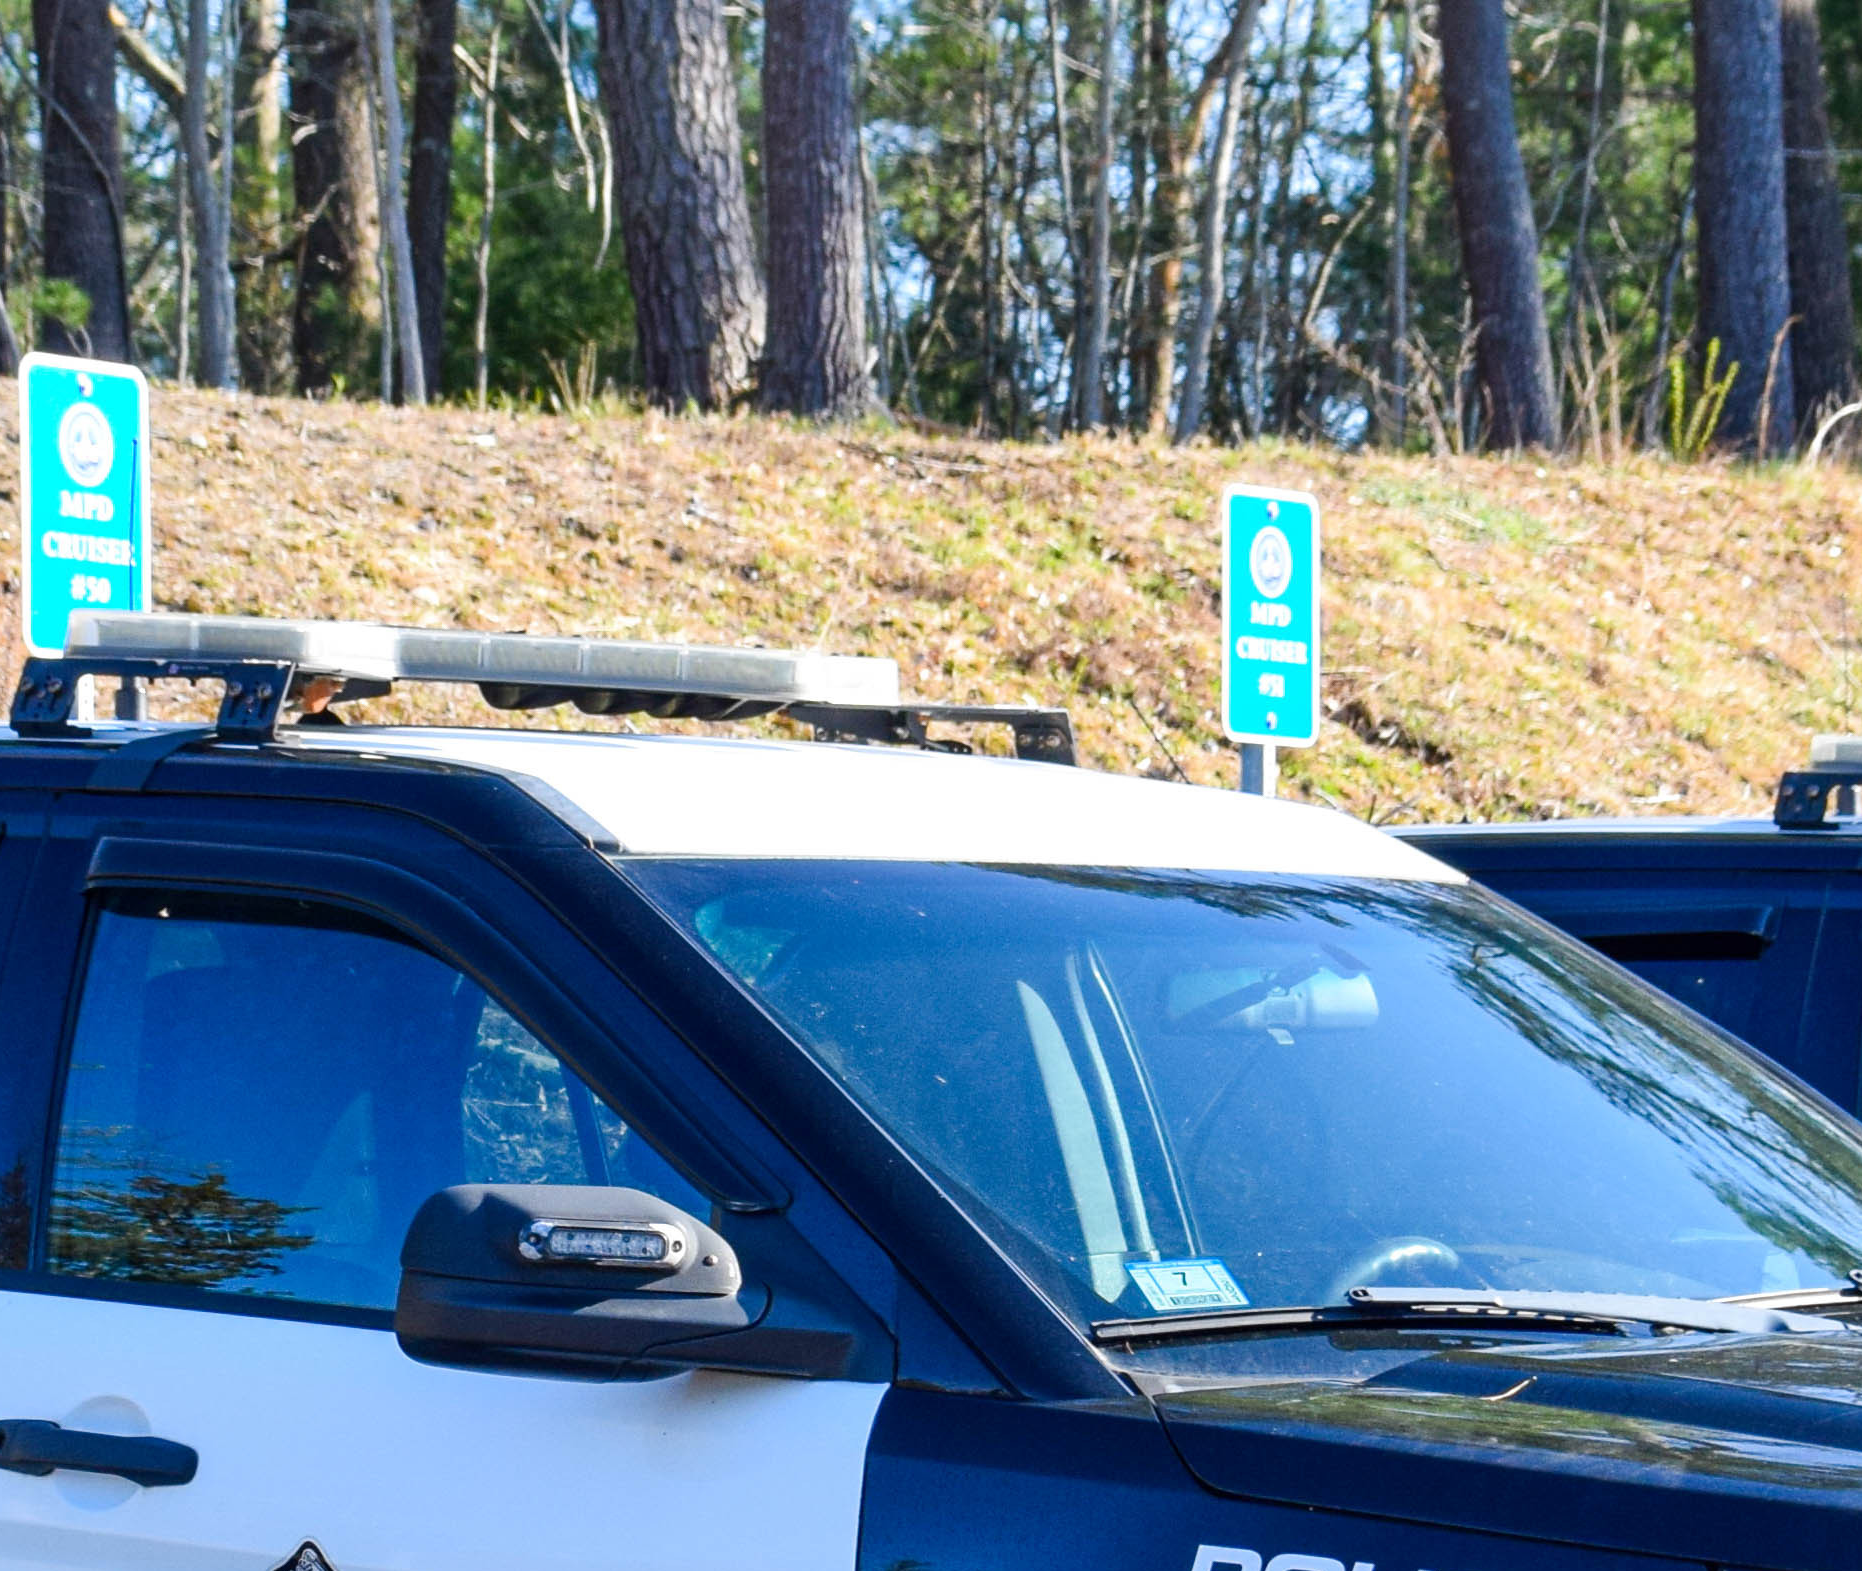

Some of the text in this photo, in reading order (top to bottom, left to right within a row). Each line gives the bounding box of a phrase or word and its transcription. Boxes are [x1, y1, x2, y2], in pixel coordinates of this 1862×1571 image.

[58, 489, 115, 522] MPD
[41, 530, 137, 568] CRUISER
[70, 573, 112, 604] #50
[1172, 1271, 1188, 1287] 7
